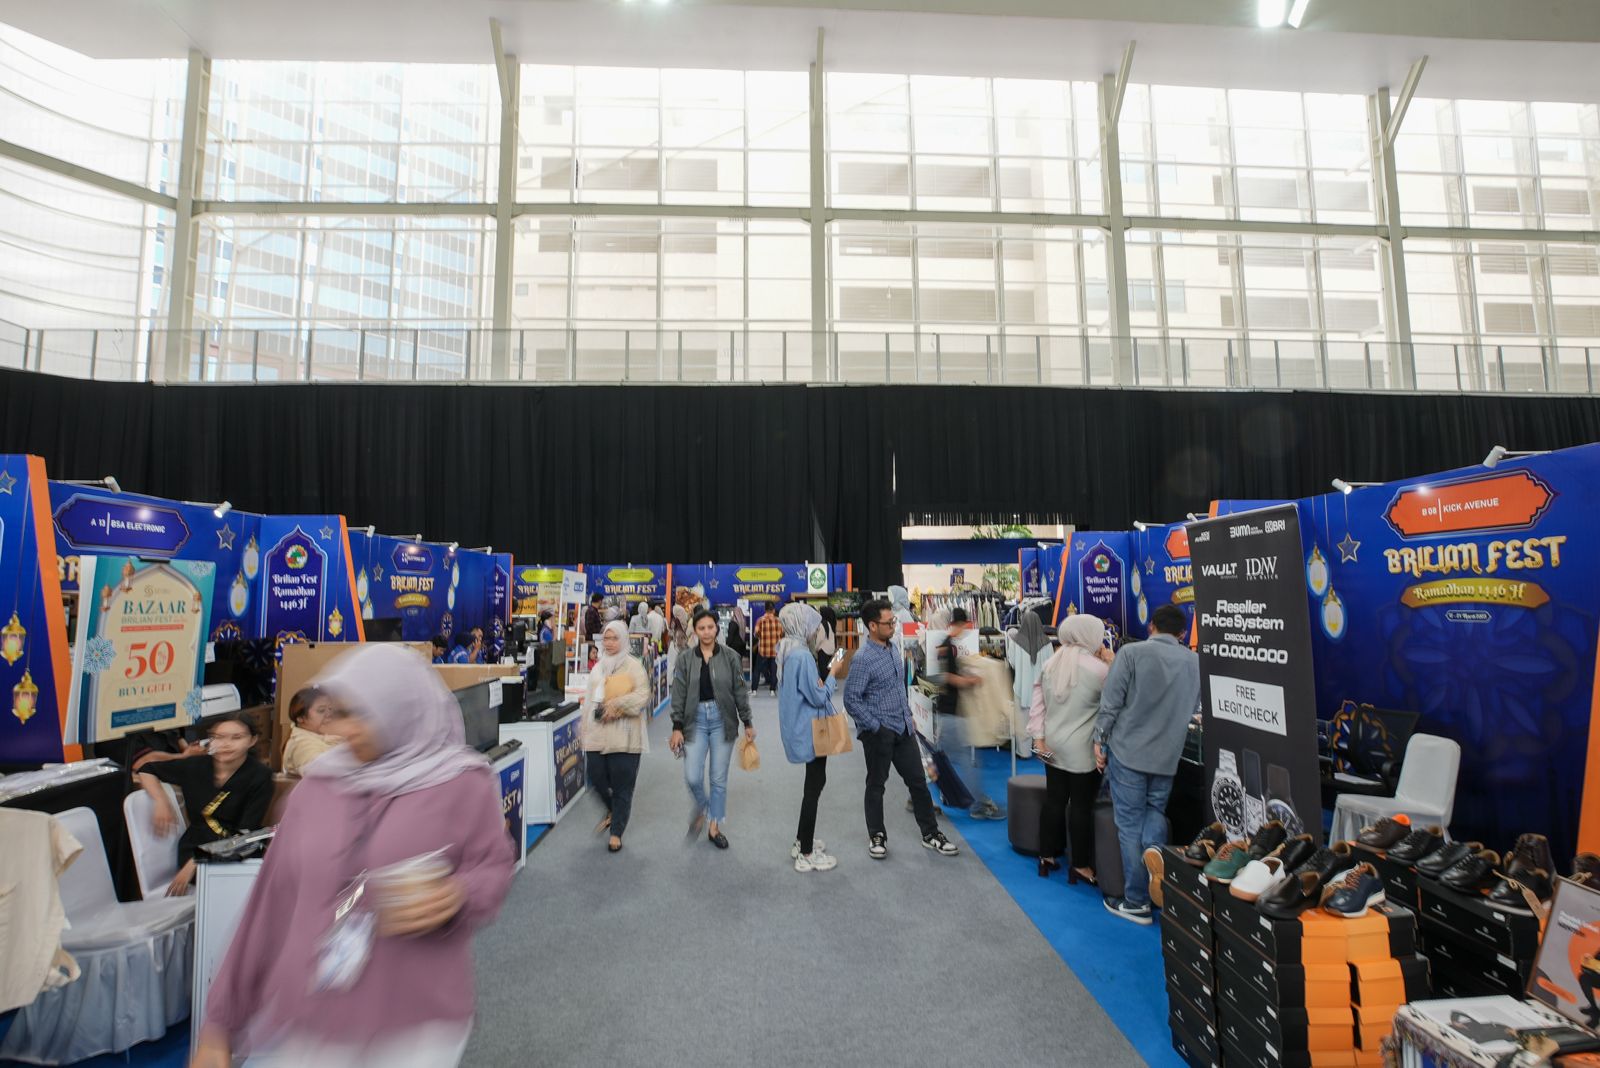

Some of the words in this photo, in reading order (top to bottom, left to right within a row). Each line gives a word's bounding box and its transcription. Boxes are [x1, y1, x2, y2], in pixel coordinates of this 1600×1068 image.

[1443, 502, 1462, 512] KICK
[1464, 498, 1500, 510] AVENUE
[90, 518, 97, 527] A
[126, 521, 166, 534] ELECTRONIC
[1383, 542, 1483, 579] BRILIAN
[1485, 535, 1567, 574] FEST
[1201, 562, 1238, 577] VAULT
[1244, 556, 1277, 576] IDW
[272, 574, 300, 585] Brilian
[300, 574, 318, 584] Fest
[1163, 565, 1194, 586] BRILIA
[272, 586, 316, 597] Ramadhan
[390, 575, 418, 593] BRILIAN
[418, 577, 434, 592] FEST
[604, 584, 636, 595] BRILIAN
[636, 584, 657, 593] FEST
[733, 583, 765, 594] BRILIAN
[765, 584, 786, 593] FEST
[1086, 586, 1119, 595] Ramadhan
[1413, 582, 1475, 601] Ramadhan
[1478, 586, 1506, 600] 1446
[123, 600, 186, 615] BAZAAR
[1216, 600, 1267, 614] Reseller
[1224, 633, 1261, 644] DISCOUNT
[124, 640, 175, 681] 50
[1210, 643, 1288, 664] 10.000.000
[1236, 684, 1256, 701] FREE
[1218, 699, 1242, 716] LEGIT
[1243, 705, 1279, 726] CHECK
[503, 788, 517, 814] EST
